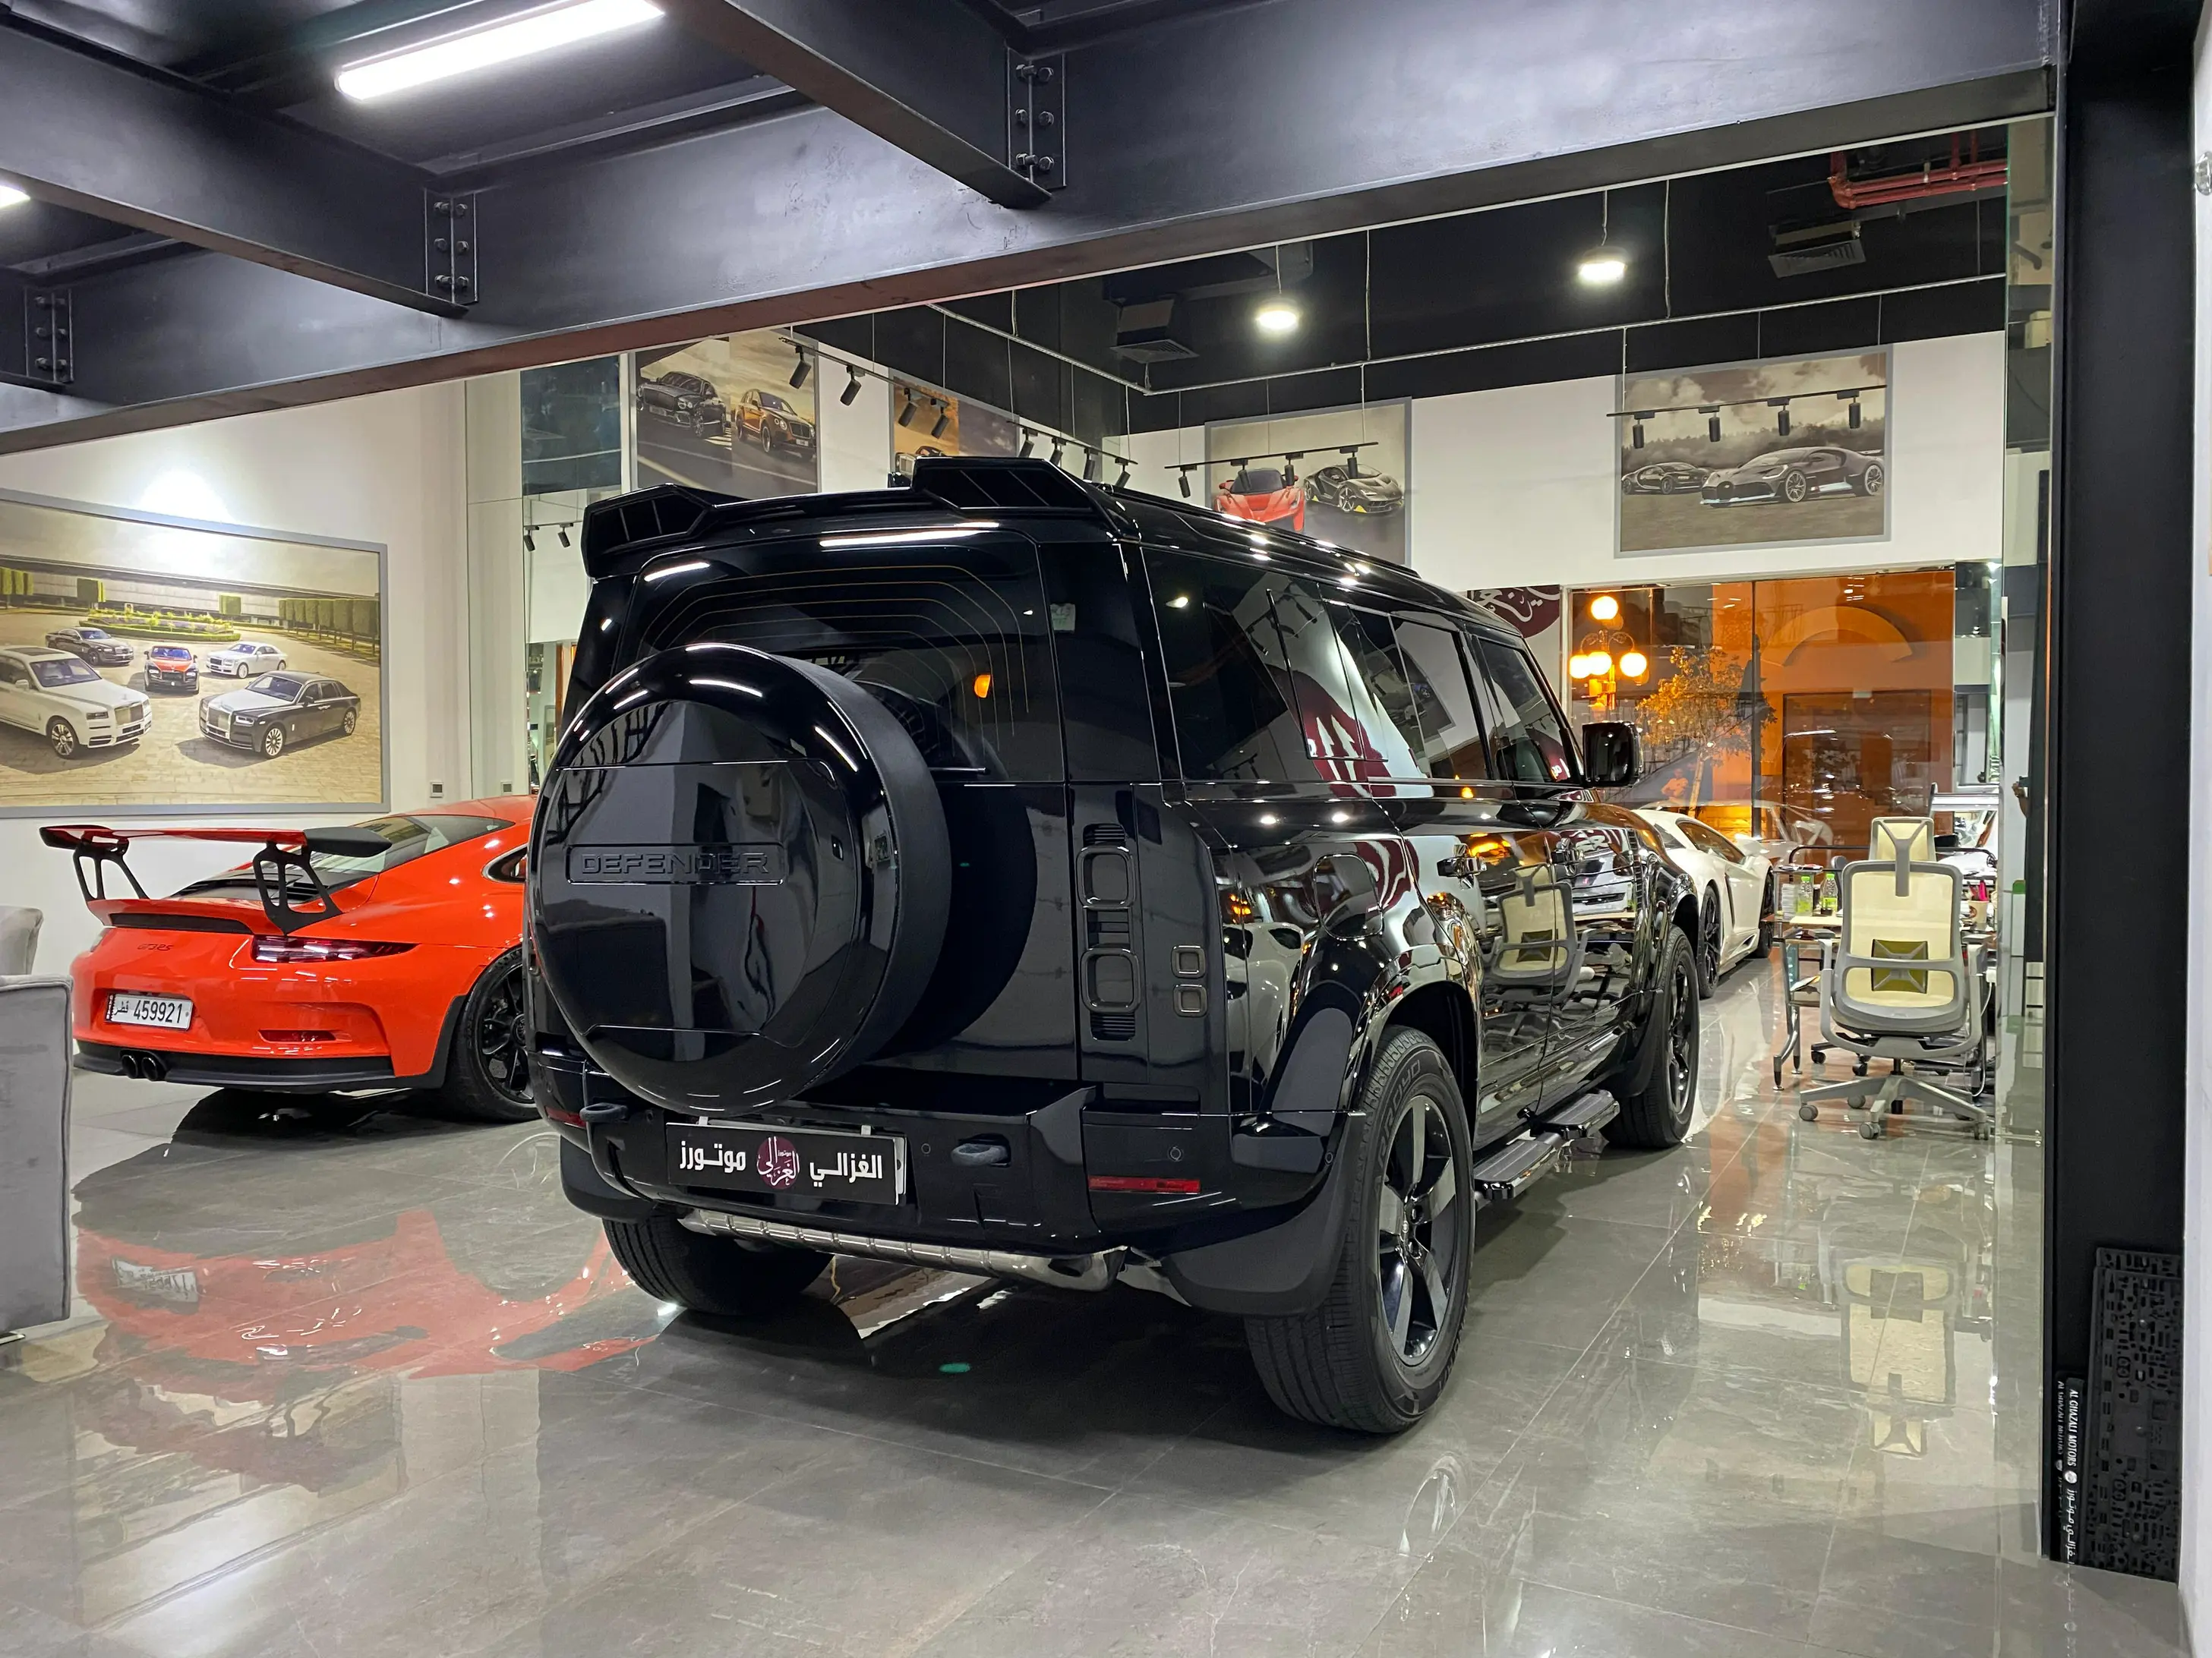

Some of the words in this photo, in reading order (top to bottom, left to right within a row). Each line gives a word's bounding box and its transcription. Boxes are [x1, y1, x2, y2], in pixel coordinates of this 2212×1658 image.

[581, 852, 771, 875] DEFENDER
[133, 1000, 182, 1023] 459921
[680, 1140, 746, 1174] موتورز
[809, 1152, 882, 1188] الغزالي
[2069, 1388, 2079, 1398] AL
[2068, 1400, 2079, 1433] GHAZALI
[2067, 1434, 2078, 1467] MOTORS
